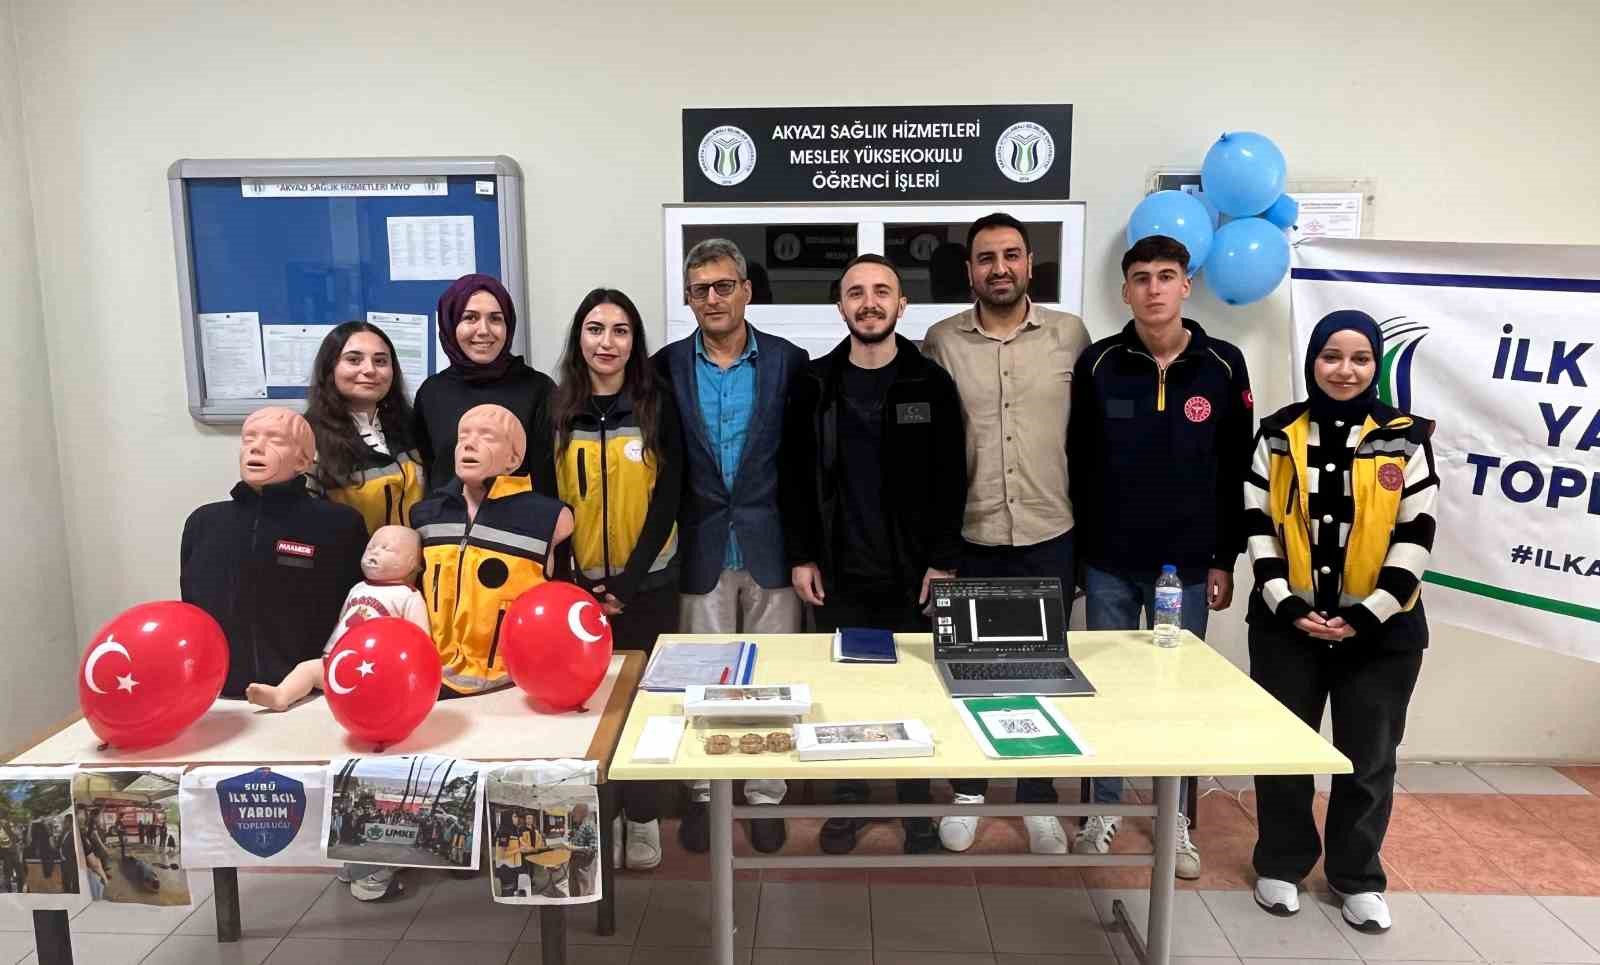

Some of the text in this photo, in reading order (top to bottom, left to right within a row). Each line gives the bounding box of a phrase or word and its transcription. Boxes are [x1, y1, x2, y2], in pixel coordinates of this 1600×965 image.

[772, 119, 981, 140] AKYAZI SAĞLIK HİZMETLERİ
[790, 145, 963, 164] MESLEK YÜKSEKOKULU
[812, 169, 940, 192] ÖĞRENCİ İŞLERİ
[1492, 323, 1594, 388] İLK
[251, 793, 268, 803] VE
[239, 806, 288, 819] YARDIM
